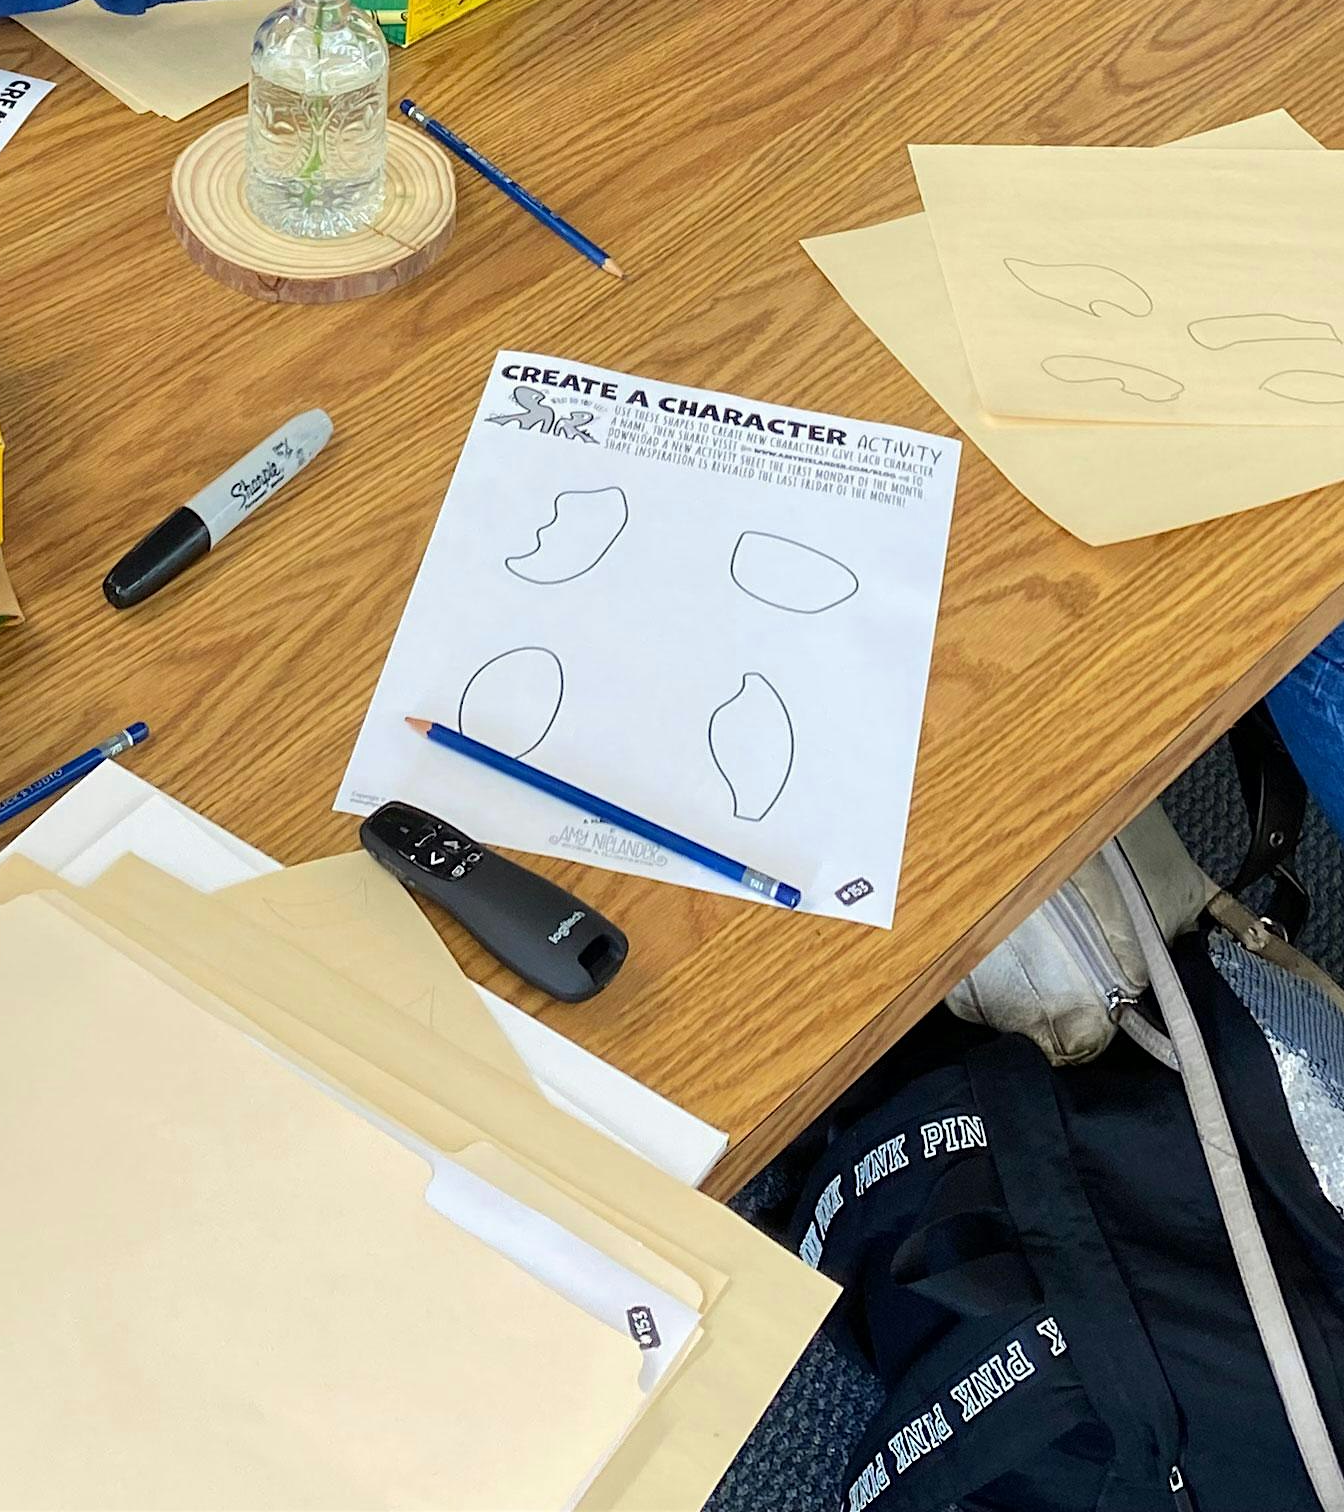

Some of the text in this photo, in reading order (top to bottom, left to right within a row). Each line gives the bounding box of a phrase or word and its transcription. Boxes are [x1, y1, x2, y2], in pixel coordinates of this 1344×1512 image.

[501, 363, 618, 402] CREATE
[626, 388, 650, 410] A
[657, 395, 849, 447] CHARACTER
[856, 436, 943, 465] ACTIVITY
[612, 404, 631, 418] USE
[697, 421, 709, 434] TO
[710, 424, 743, 441] CREATE
[745, 431, 767, 445] NEW
[831, 447, 854, 462] GIVE
[883, 456, 934, 478] CHARACTER
[607, 427, 659, 447] DOWNLOAD
[661, 438, 669, 449] A
[670, 440, 691, 454] NEW
[814, 467, 855, 487] MONDAY
[610, 415, 617, 426] A
[911, 474, 923, 487] TO
[698, 457, 708, 469] IS
[230, 460, 280, 511] Sharpie
[558, 822, 589, 845] AMY
[547, 910, 586, 946] logitech
[920, 1115, 987, 1158] PIN
[950, 1339, 1036, 1423] PINK
